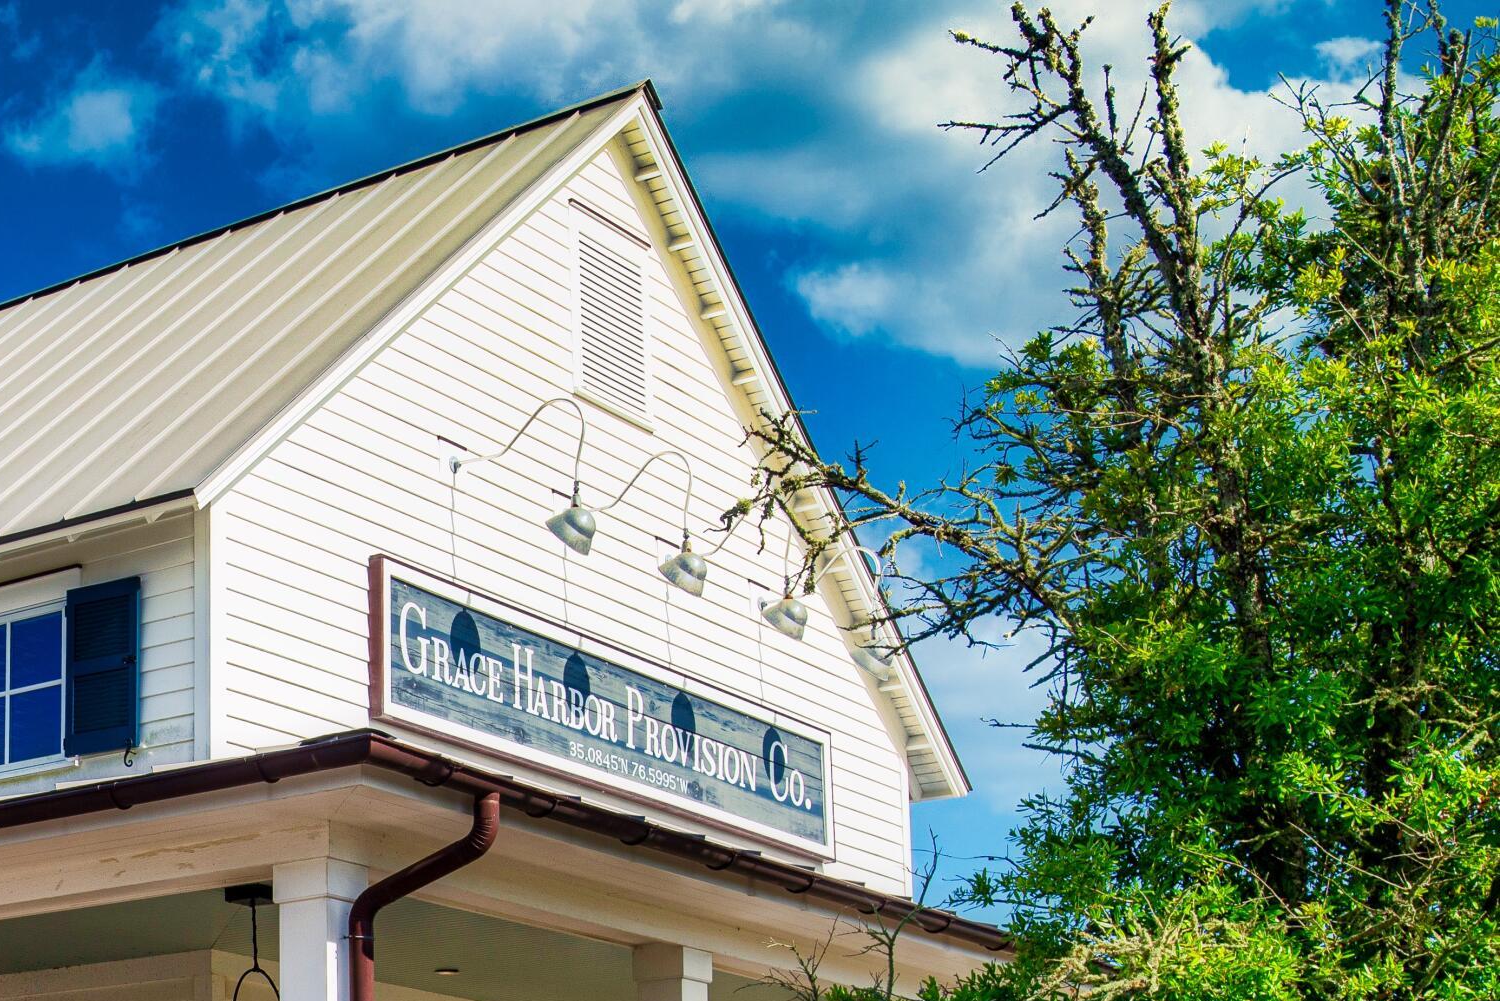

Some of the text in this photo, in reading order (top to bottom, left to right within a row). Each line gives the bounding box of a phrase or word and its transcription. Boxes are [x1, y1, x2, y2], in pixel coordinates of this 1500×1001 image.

[399, 601, 503, 703] GRACE
[512, 643, 618, 744] HARBOR
[626, 686, 756, 792] PROVISION
